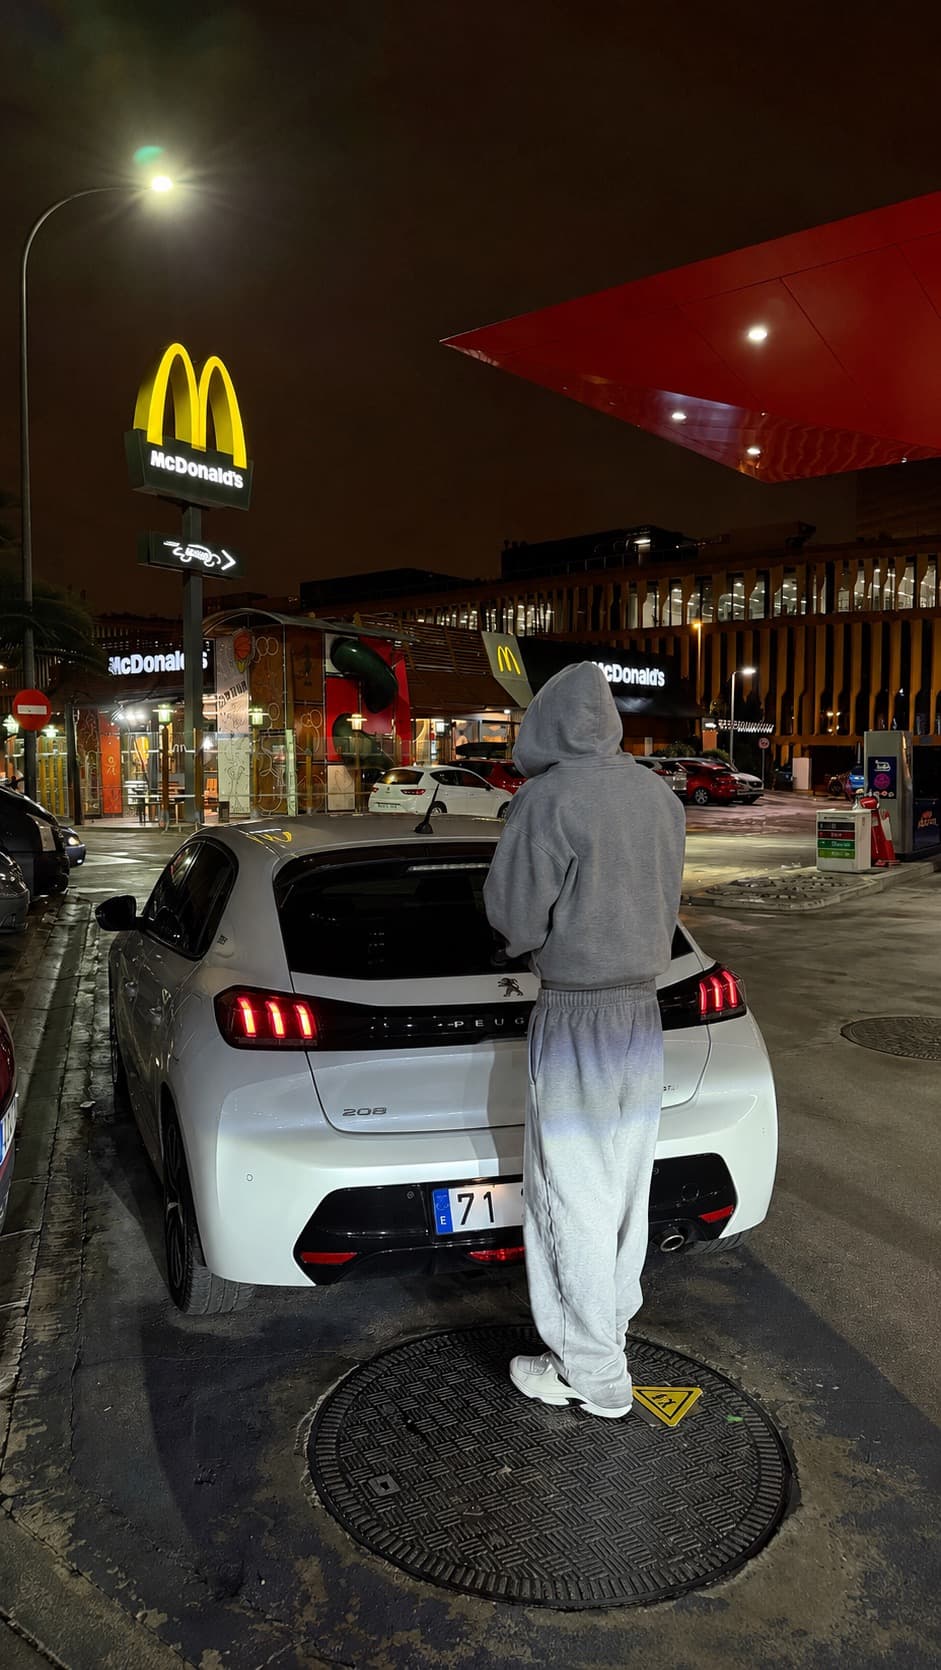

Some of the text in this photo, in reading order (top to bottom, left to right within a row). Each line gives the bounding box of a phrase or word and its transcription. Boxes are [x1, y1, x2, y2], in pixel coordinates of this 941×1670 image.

[150, 449, 244, 489] McDonald's
[454, 1017, 525, 1028] PEUG
[342, 1106, 387, 1117] 208
[440, 1191, 496, 1226] E 71
